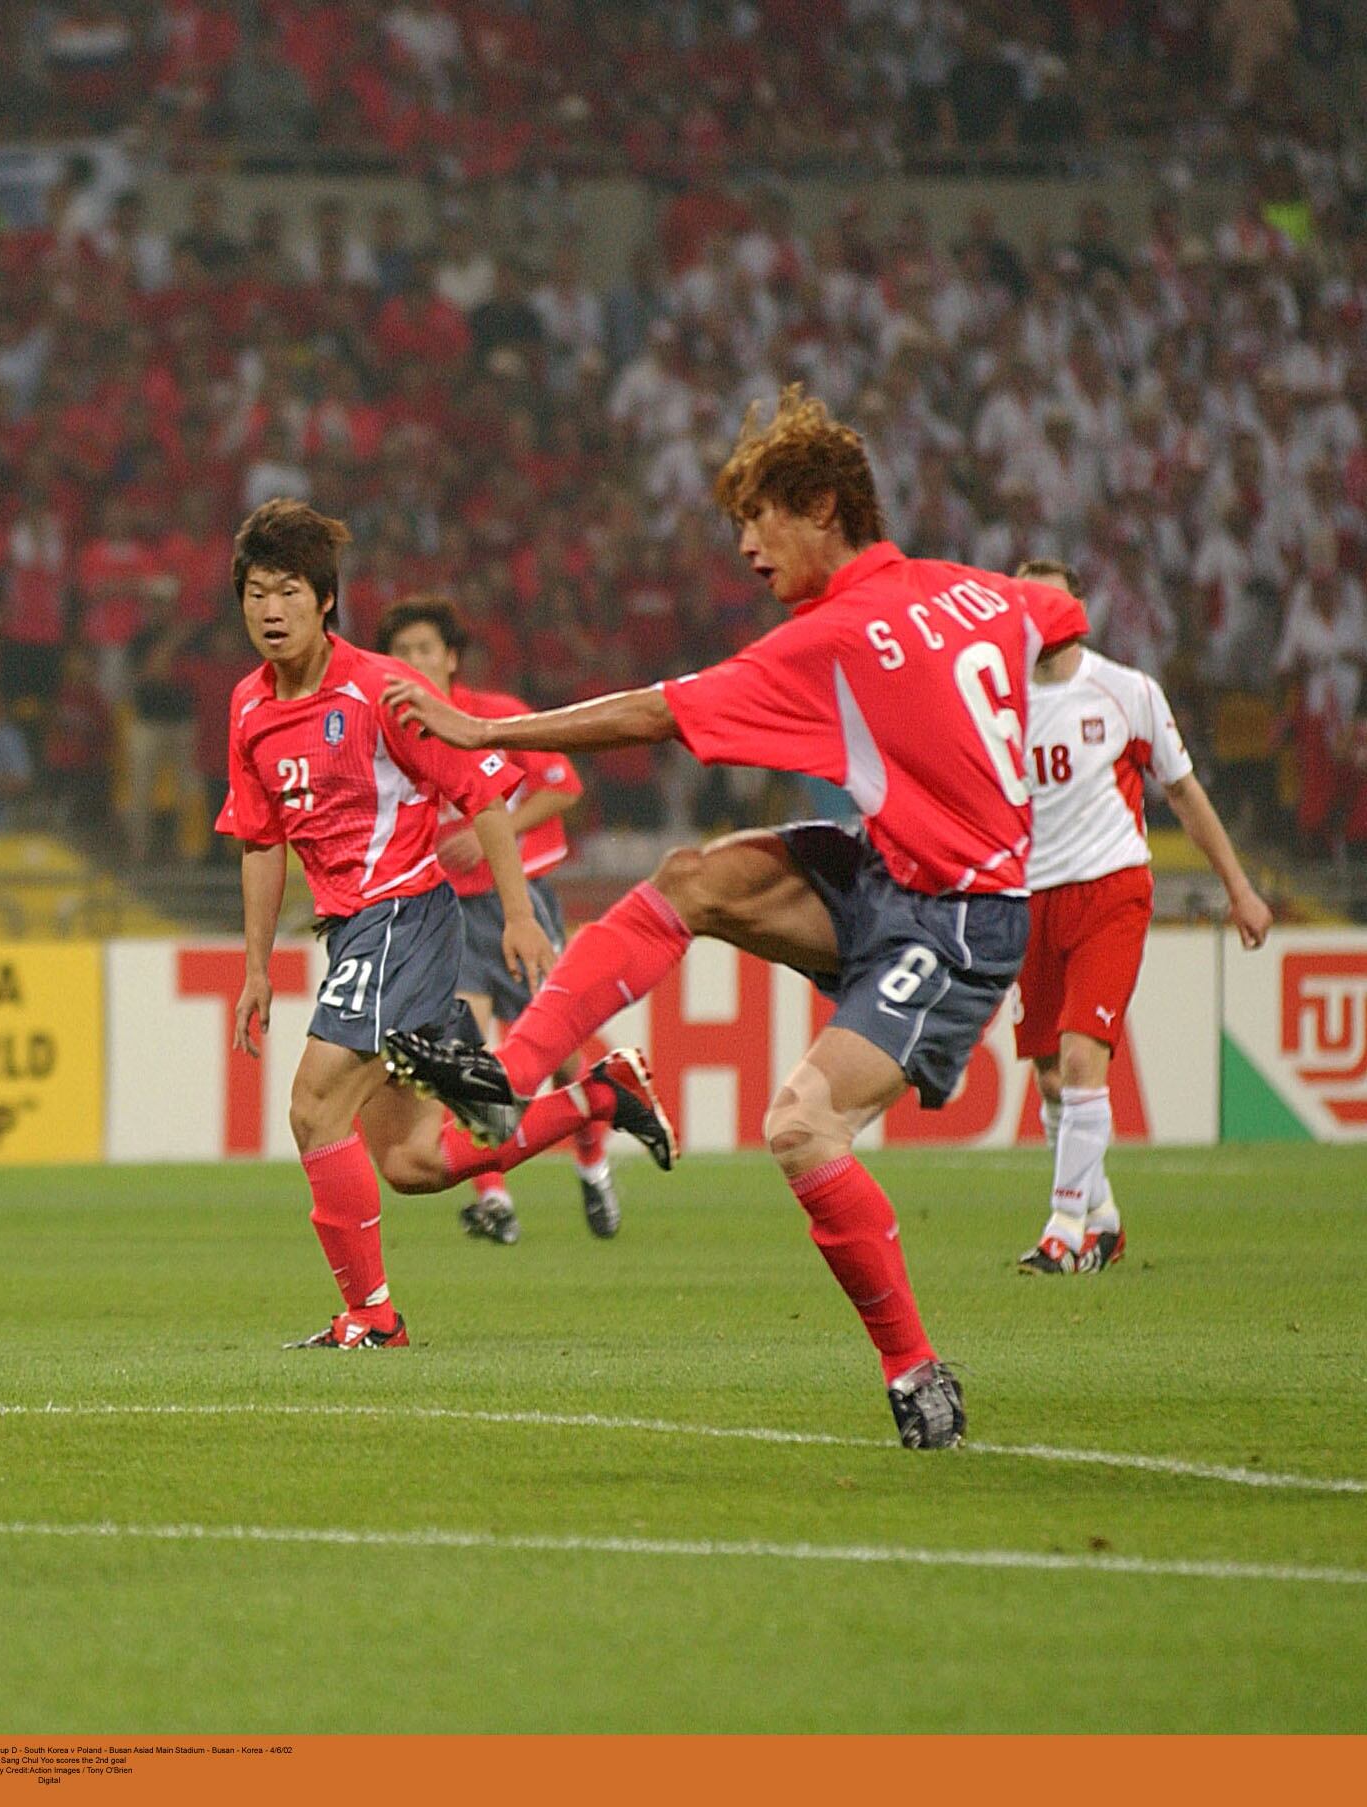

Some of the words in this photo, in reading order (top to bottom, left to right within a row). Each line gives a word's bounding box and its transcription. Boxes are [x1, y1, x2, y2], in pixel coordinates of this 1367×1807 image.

[954, 640, 1029, 807] 6
[277, 757, 314, 812] 21
[1032, 744, 1073, 786] 18
[319, 959, 373, 1011] 21
[878, 945, 938, 1003] 6
